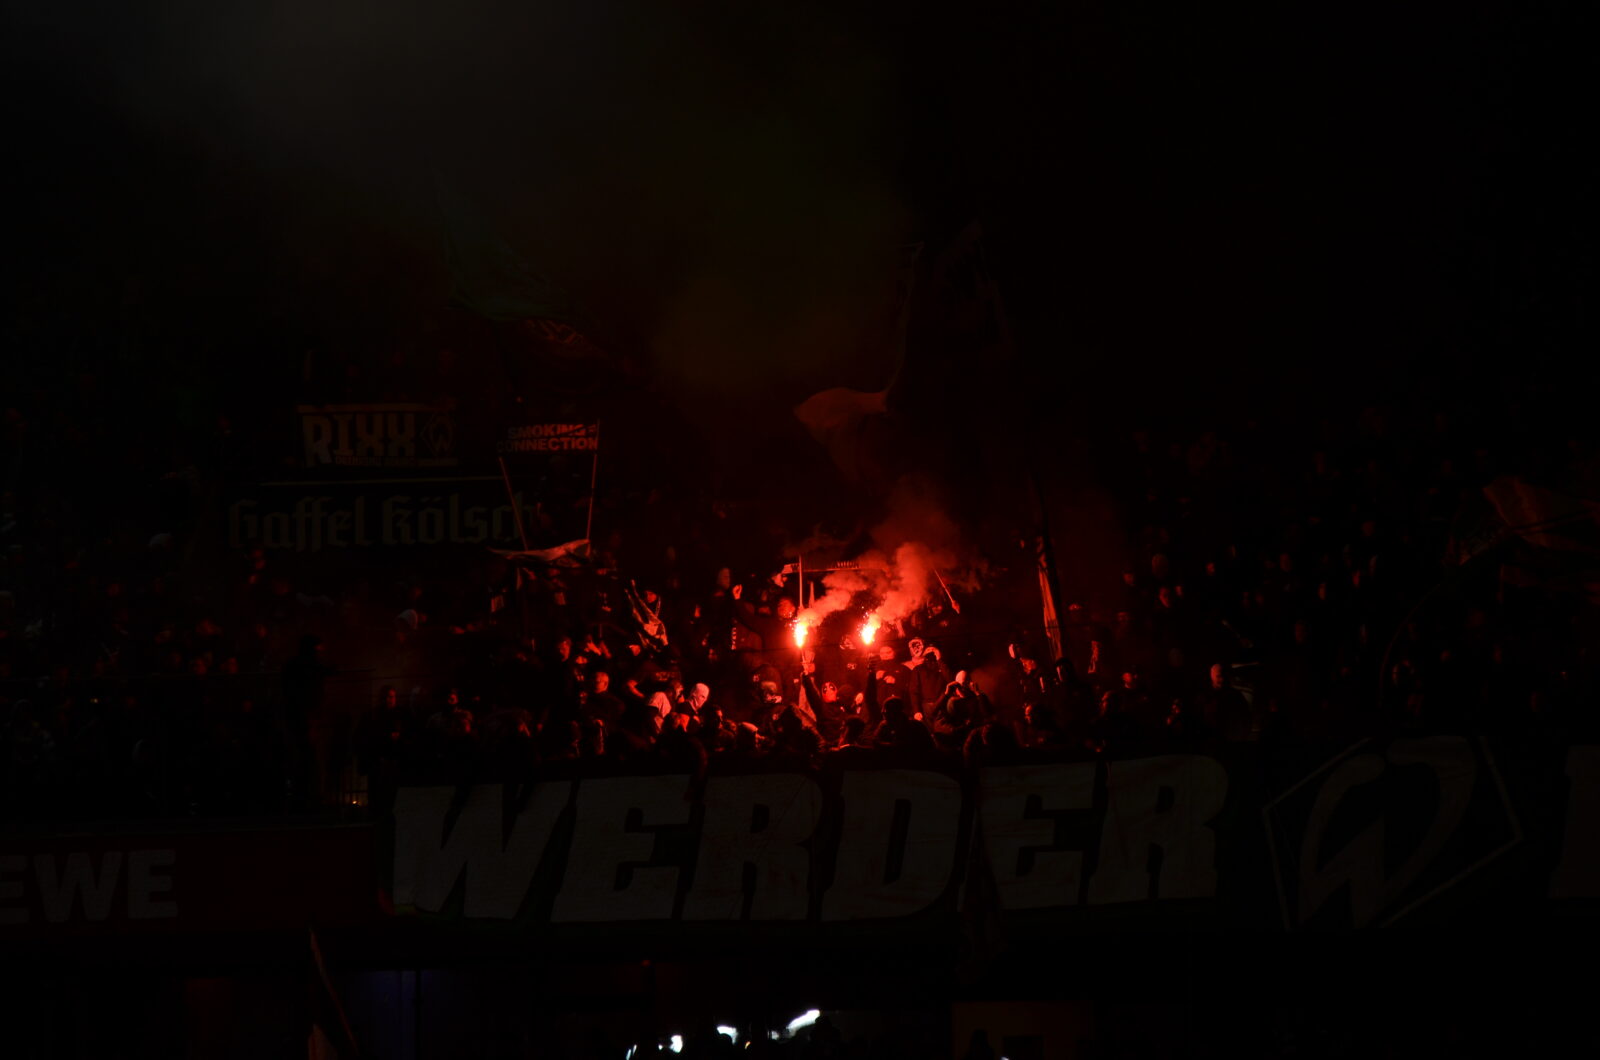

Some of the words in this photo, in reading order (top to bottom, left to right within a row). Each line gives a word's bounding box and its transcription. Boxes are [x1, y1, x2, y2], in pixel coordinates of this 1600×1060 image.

[302, 412, 416, 467] RIXX
[496, 437, 598, 453] CONNECTION
[507, 423, 587, 439] SMOKING
[227, 495, 375, 553] Gaffel
[392, 753, 1229, 922] WERDER
